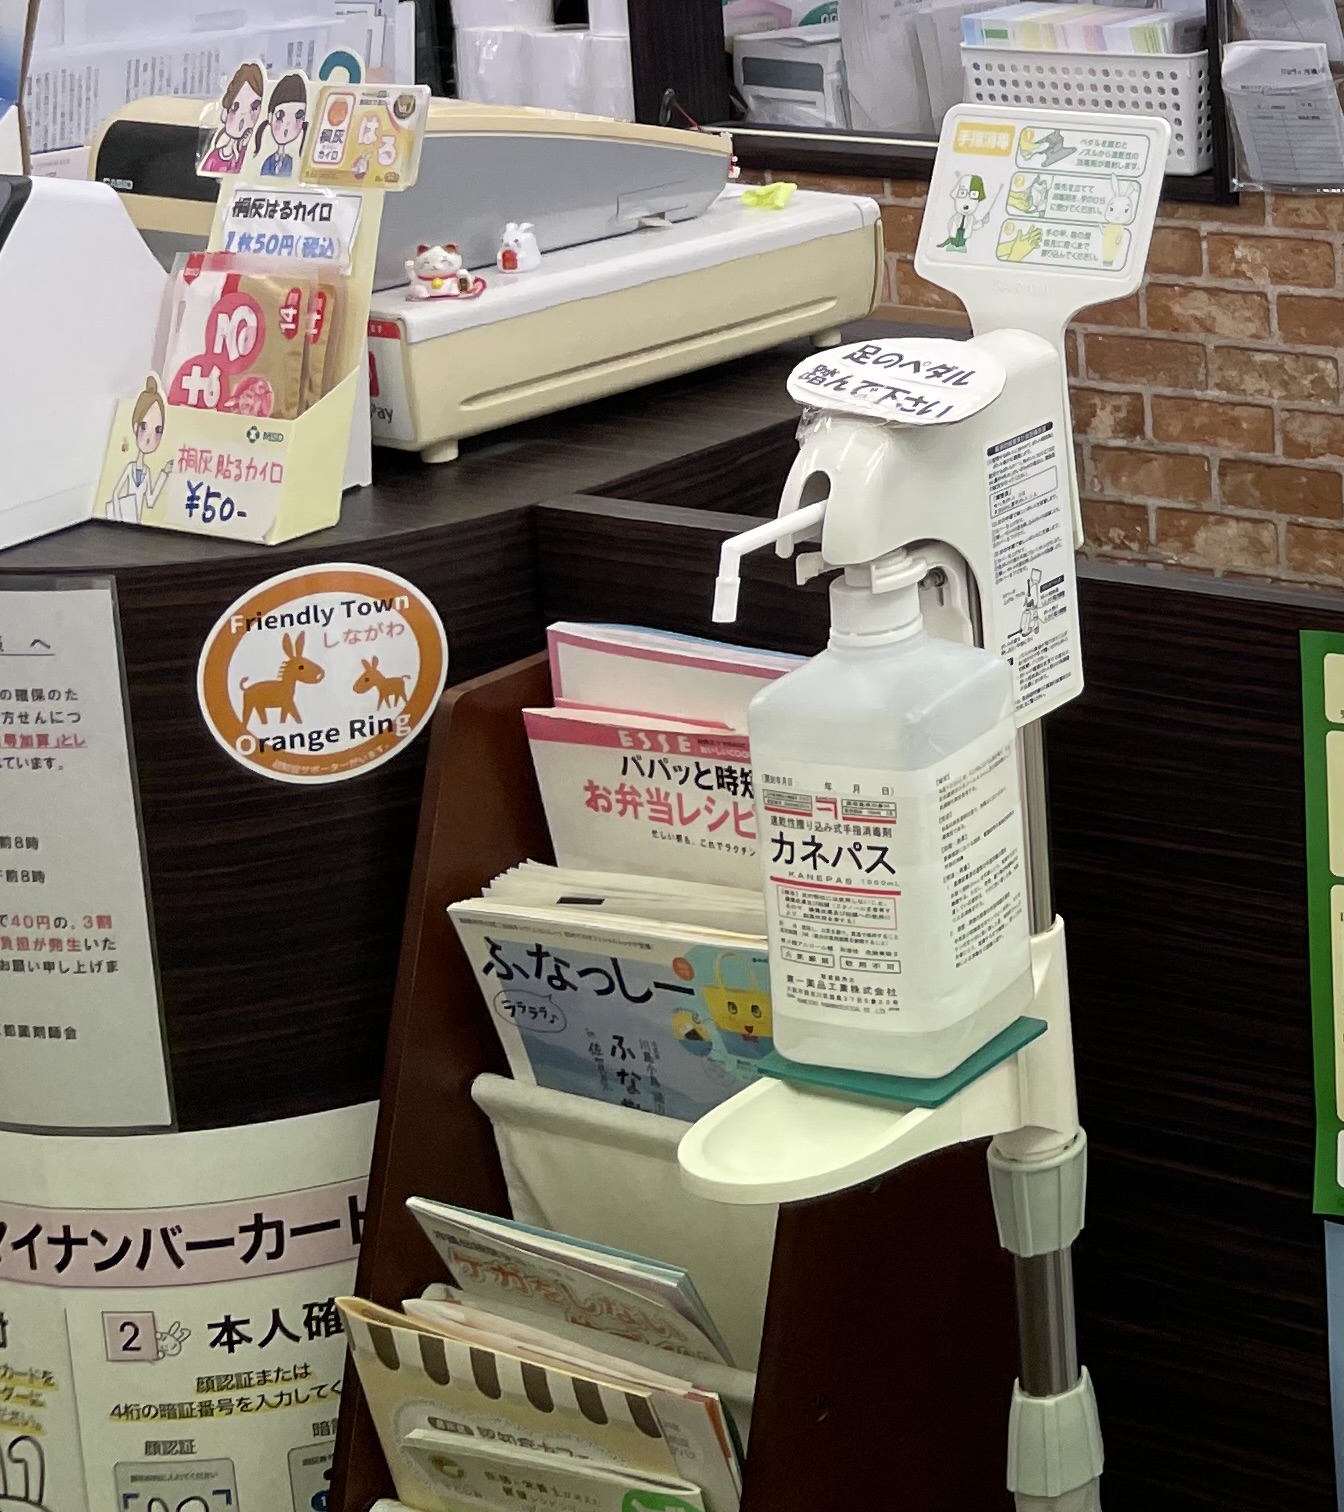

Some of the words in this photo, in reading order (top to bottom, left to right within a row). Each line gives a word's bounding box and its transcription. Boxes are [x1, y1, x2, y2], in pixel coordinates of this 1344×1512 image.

[842, 344, 977, 388] 足のペダル
[797, 363, 955, 419] 踏んで下さい
[262, 431, 285, 443] MSD
[177, 444, 284, 485] 桐灰貼るカイロ
[185, 480, 248, 524] ¥50-
[229, 603, 335, 635] Friendly
[340, 594, 410, 620] Town
[322, 622, 405, 649] しながわ
[235, 722, 340, 757] Orange
[348, 713, 412, 741] Ring
[618, 729, 692, 754] ESSE
[770, 831, 897, 875] カネパス
[0, 868, 46, 884] 前8時
[788, 871, 853, 886] KANEPAS
[118, 1320, 142, 1352] 2
[206, 1296, 345, 1355] 本人確
